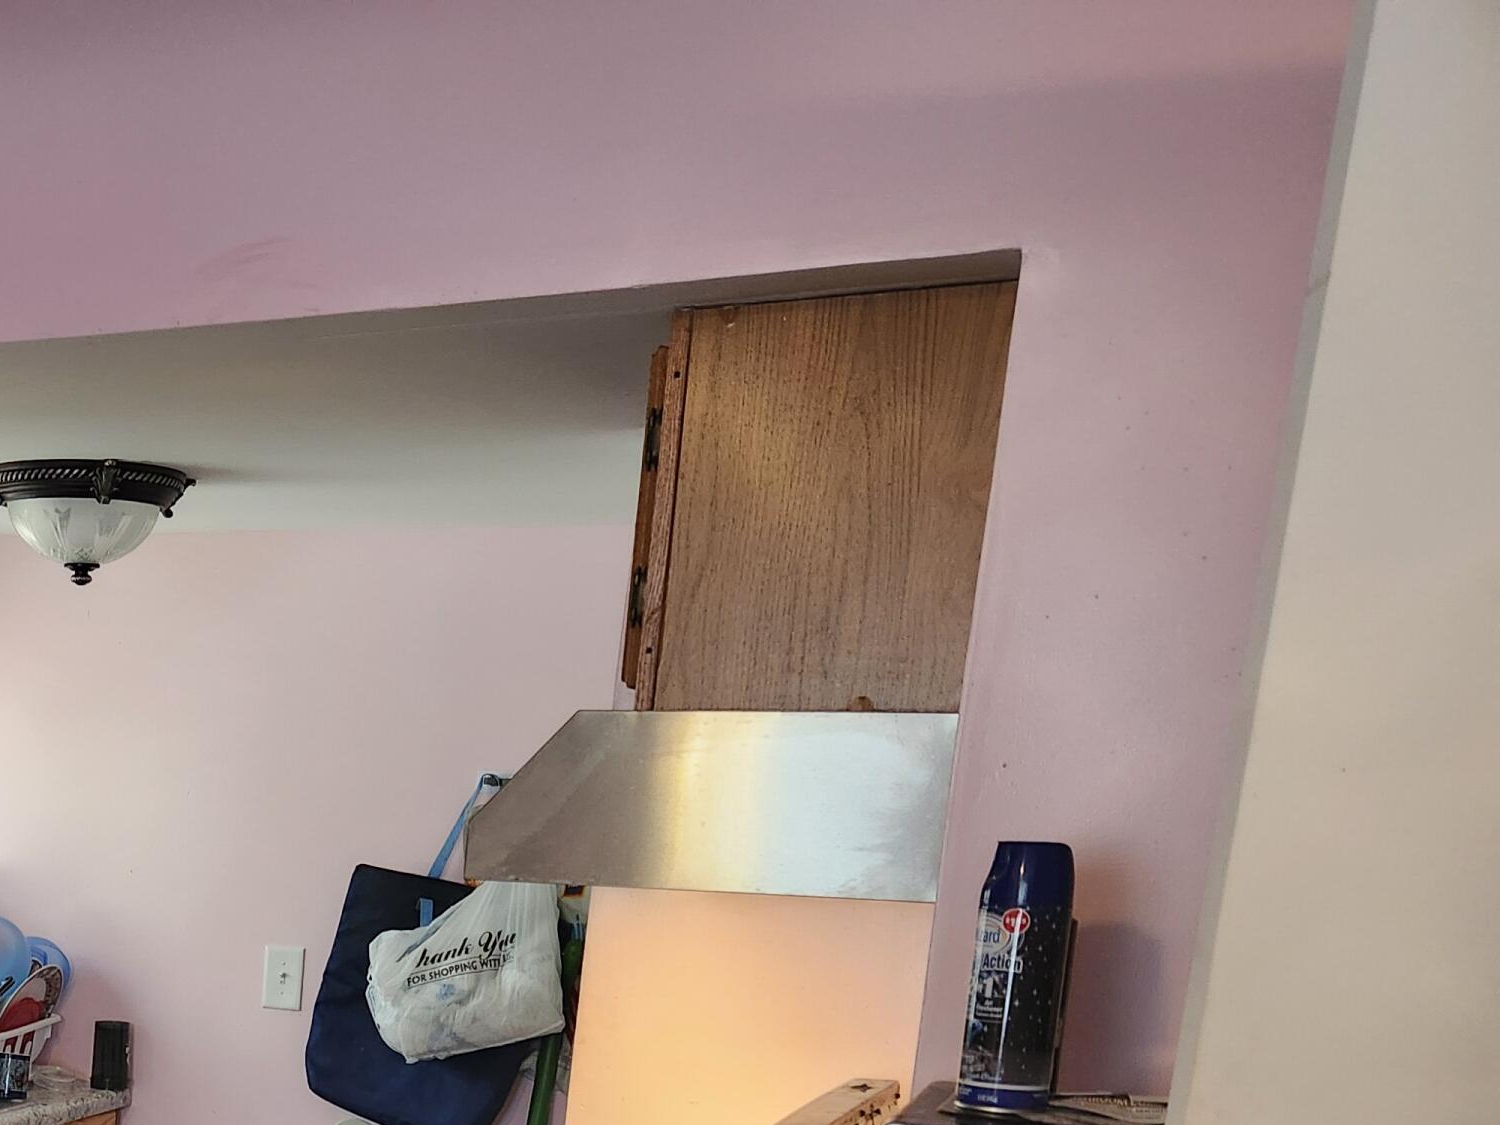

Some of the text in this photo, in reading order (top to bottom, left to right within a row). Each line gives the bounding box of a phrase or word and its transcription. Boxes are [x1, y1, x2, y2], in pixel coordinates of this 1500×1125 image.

[415, 937, 472, 968] hank
[982, 954, 1022, 972] Action
[406, 974, 427, 988] FOR
[429, 961, 478, 980] SHOPPING
